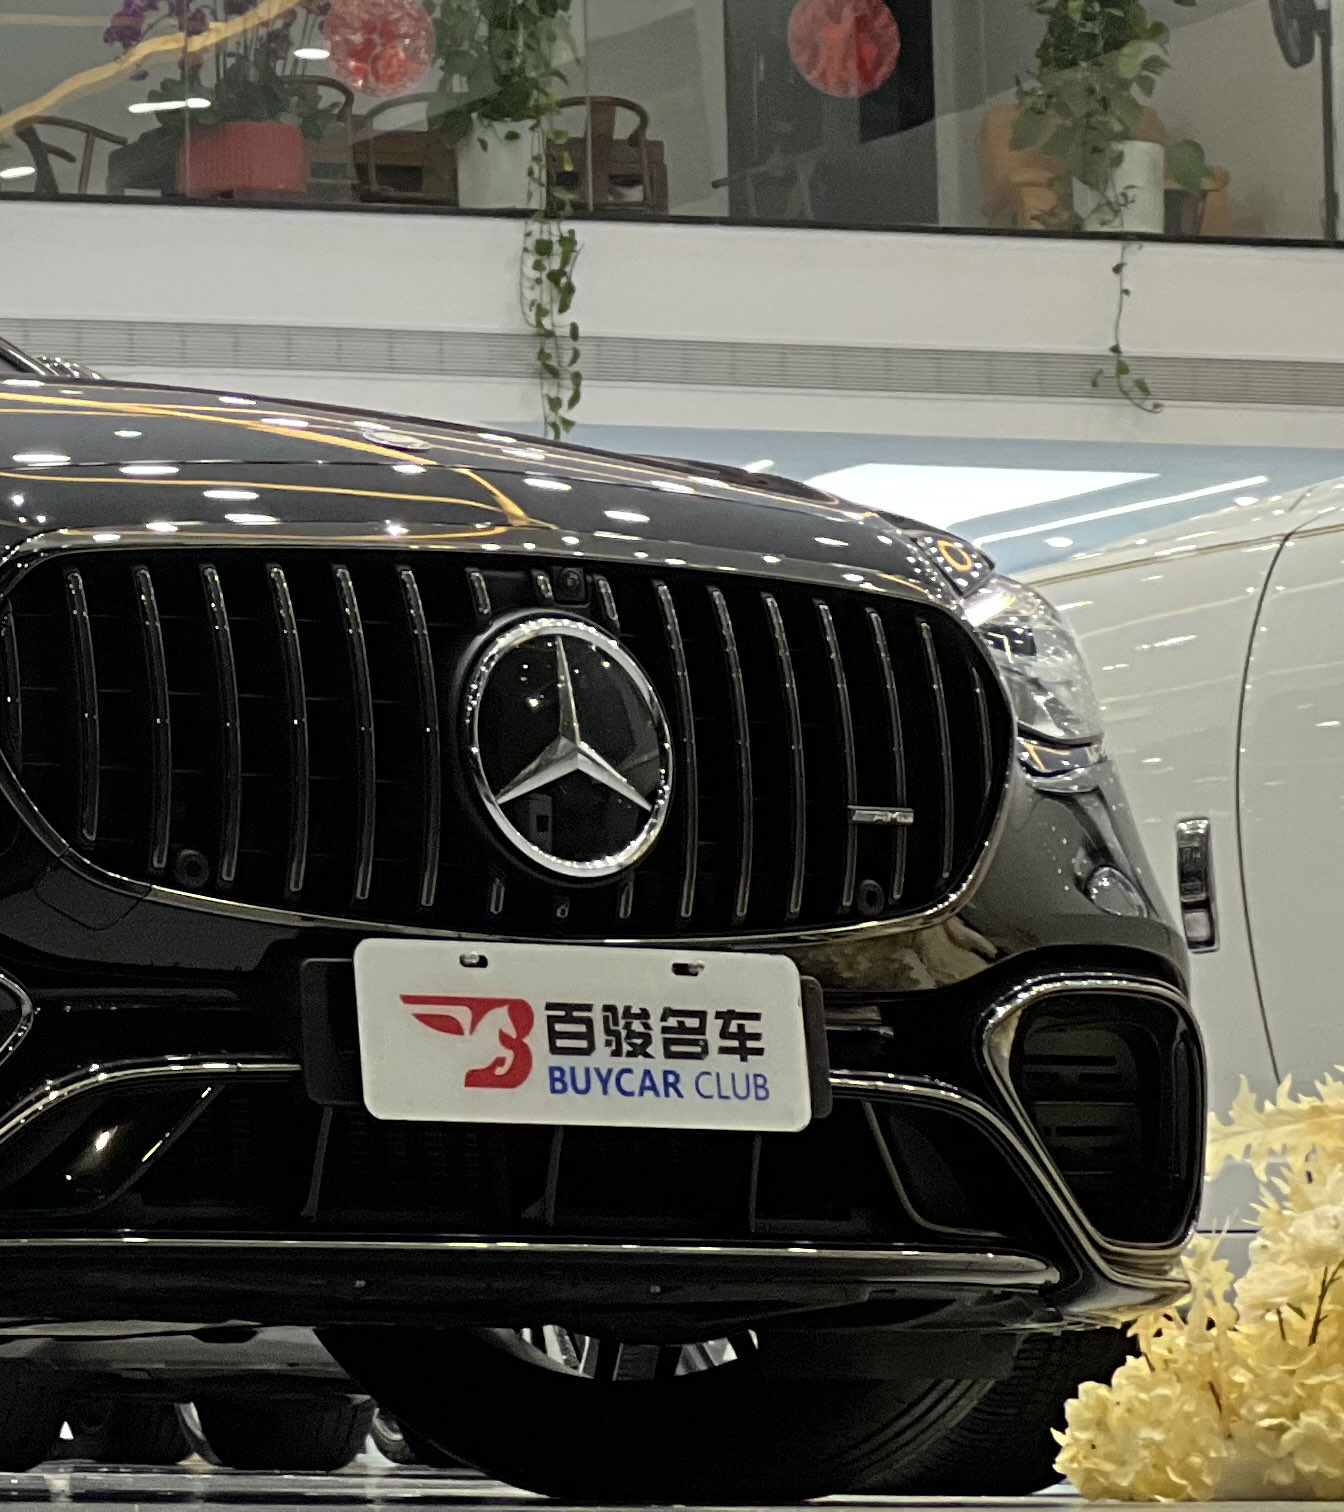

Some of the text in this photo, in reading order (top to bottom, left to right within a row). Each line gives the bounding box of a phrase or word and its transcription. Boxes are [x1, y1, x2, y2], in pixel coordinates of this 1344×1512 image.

[544, 1000, 766, 1063] 百骏名车
[547, 1065, 771, 1102] BUYCAR CLUB
